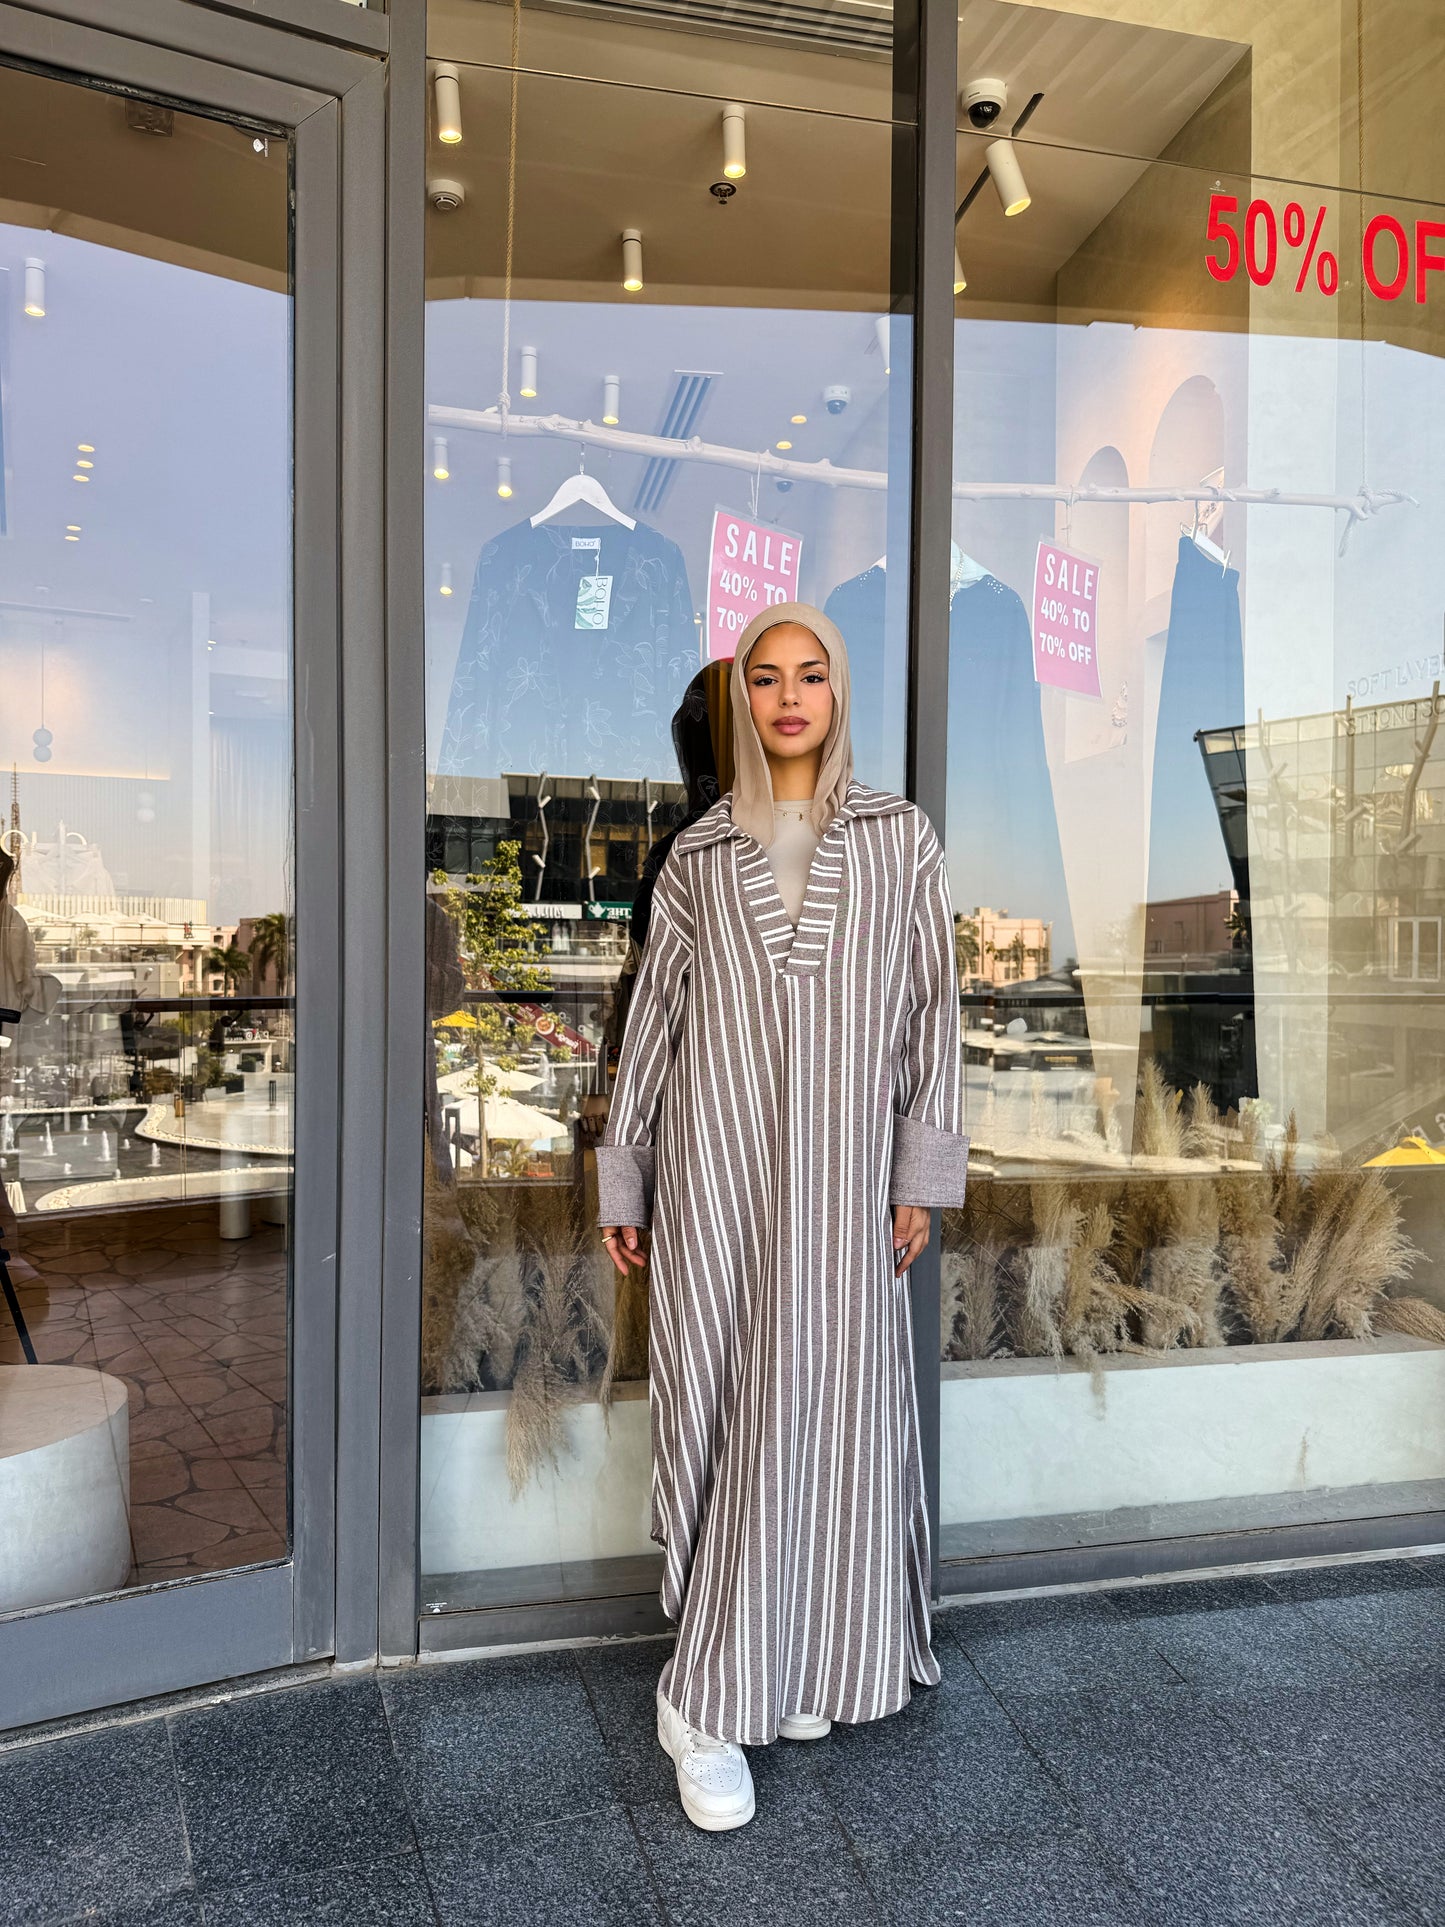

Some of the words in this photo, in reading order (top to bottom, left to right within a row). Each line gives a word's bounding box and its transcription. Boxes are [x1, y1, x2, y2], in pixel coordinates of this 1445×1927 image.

[1205, 194, 1339, 297] 50%
[1363, 214, 1445, 304] OF
[725, 523, 793, 576] SALE
[719, 569, 757, 602] 40%
[763, 582, 787, 606] TO
[1044, 553, 1094, 600] SALE
[1041, 597, 1068, 626] 40%
[1072, 607, 1090, 632] TO
[1039, 632, 1065, 658] 70%
[1068, 642, 1092, 665] OFF
[1347, 668, 1392, 699] SOFT
